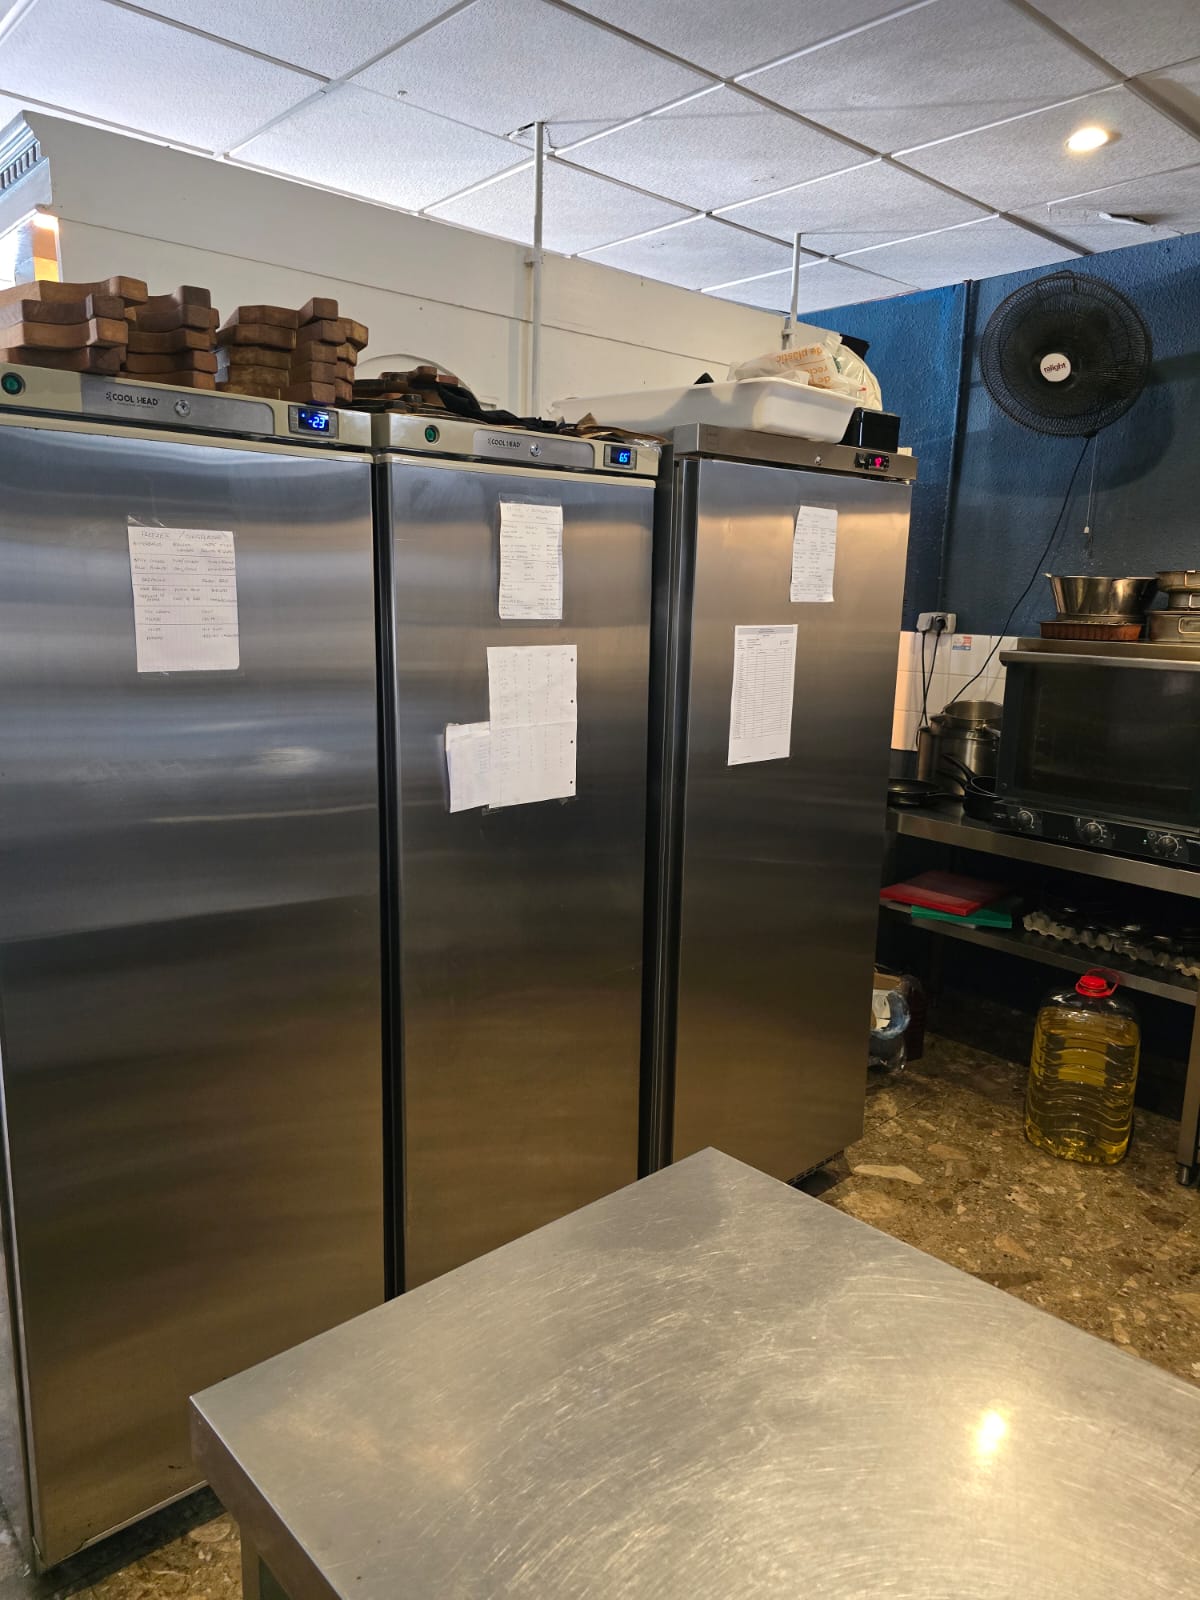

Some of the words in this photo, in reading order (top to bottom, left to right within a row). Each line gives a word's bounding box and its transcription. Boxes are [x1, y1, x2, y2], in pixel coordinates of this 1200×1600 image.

[112, 393, 135, 403] COOL
[136, 396, 159, 406] HEAD
[308, 415, 326, 429] -23
[491, 438, 506, 447] COOL
